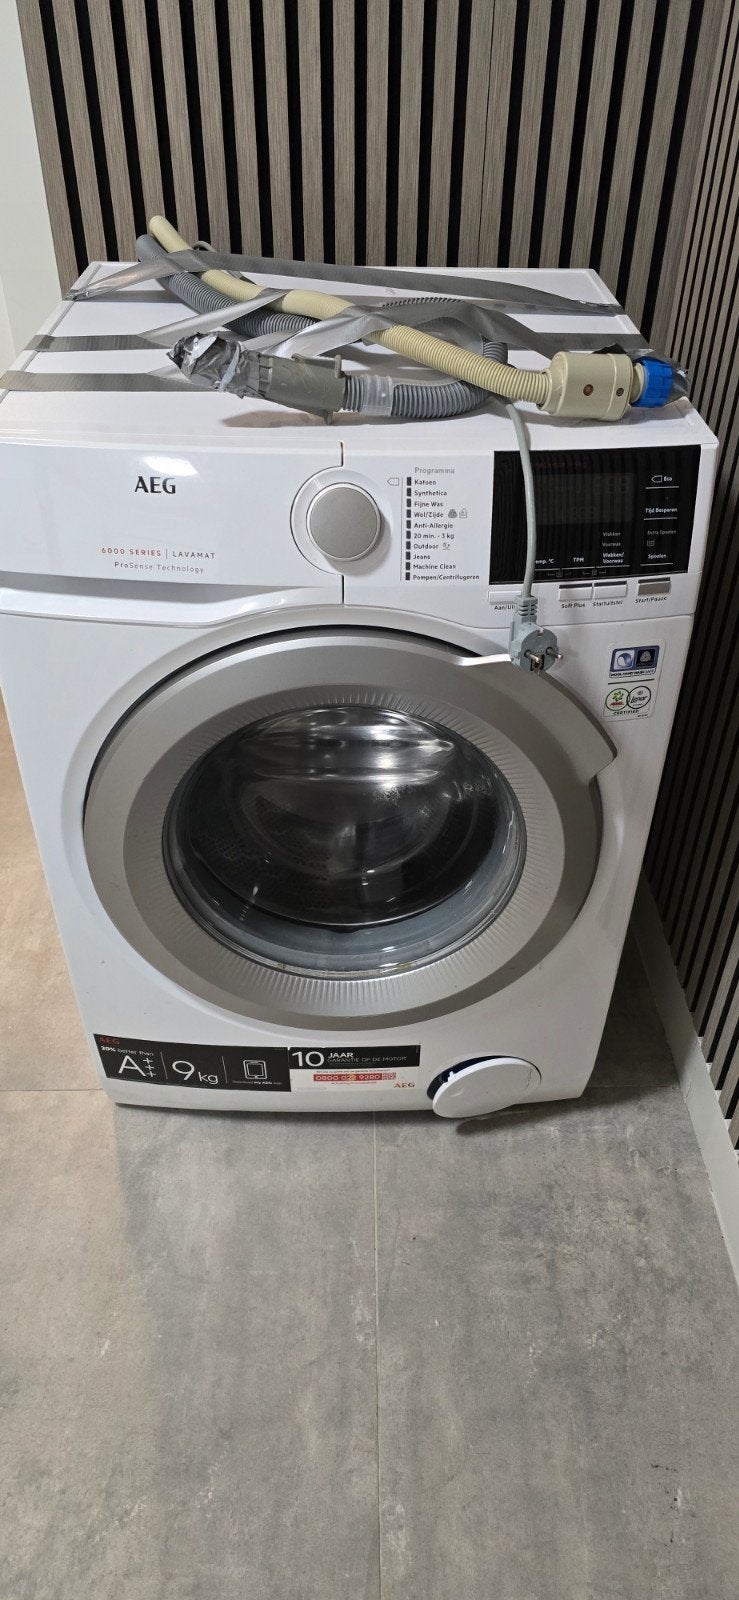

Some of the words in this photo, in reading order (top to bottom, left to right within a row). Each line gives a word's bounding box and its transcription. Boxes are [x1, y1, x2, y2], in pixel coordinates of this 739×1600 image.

[414, 467, 455, 475] Programma
[134, 475, 176, 494] AEG
[414, 511, 444, 519] Wol/Zijde
[414, 522, 454, 530] Anti-Allergie
[101, 547, 125, 555] 6000
[129, 548, 162, 557] SERIES
[172, 551, 217, 560] LAVAMAT
[114, 561, 154, 571] ProSense
[157, 564, 204, 574] Technology
[99, 1036, 120, 1045] AEG
[292, 1051, 325, 1067] 10
[171, 1061, 195, 1081] 9
[198, 1071, 219, 1085] kg
